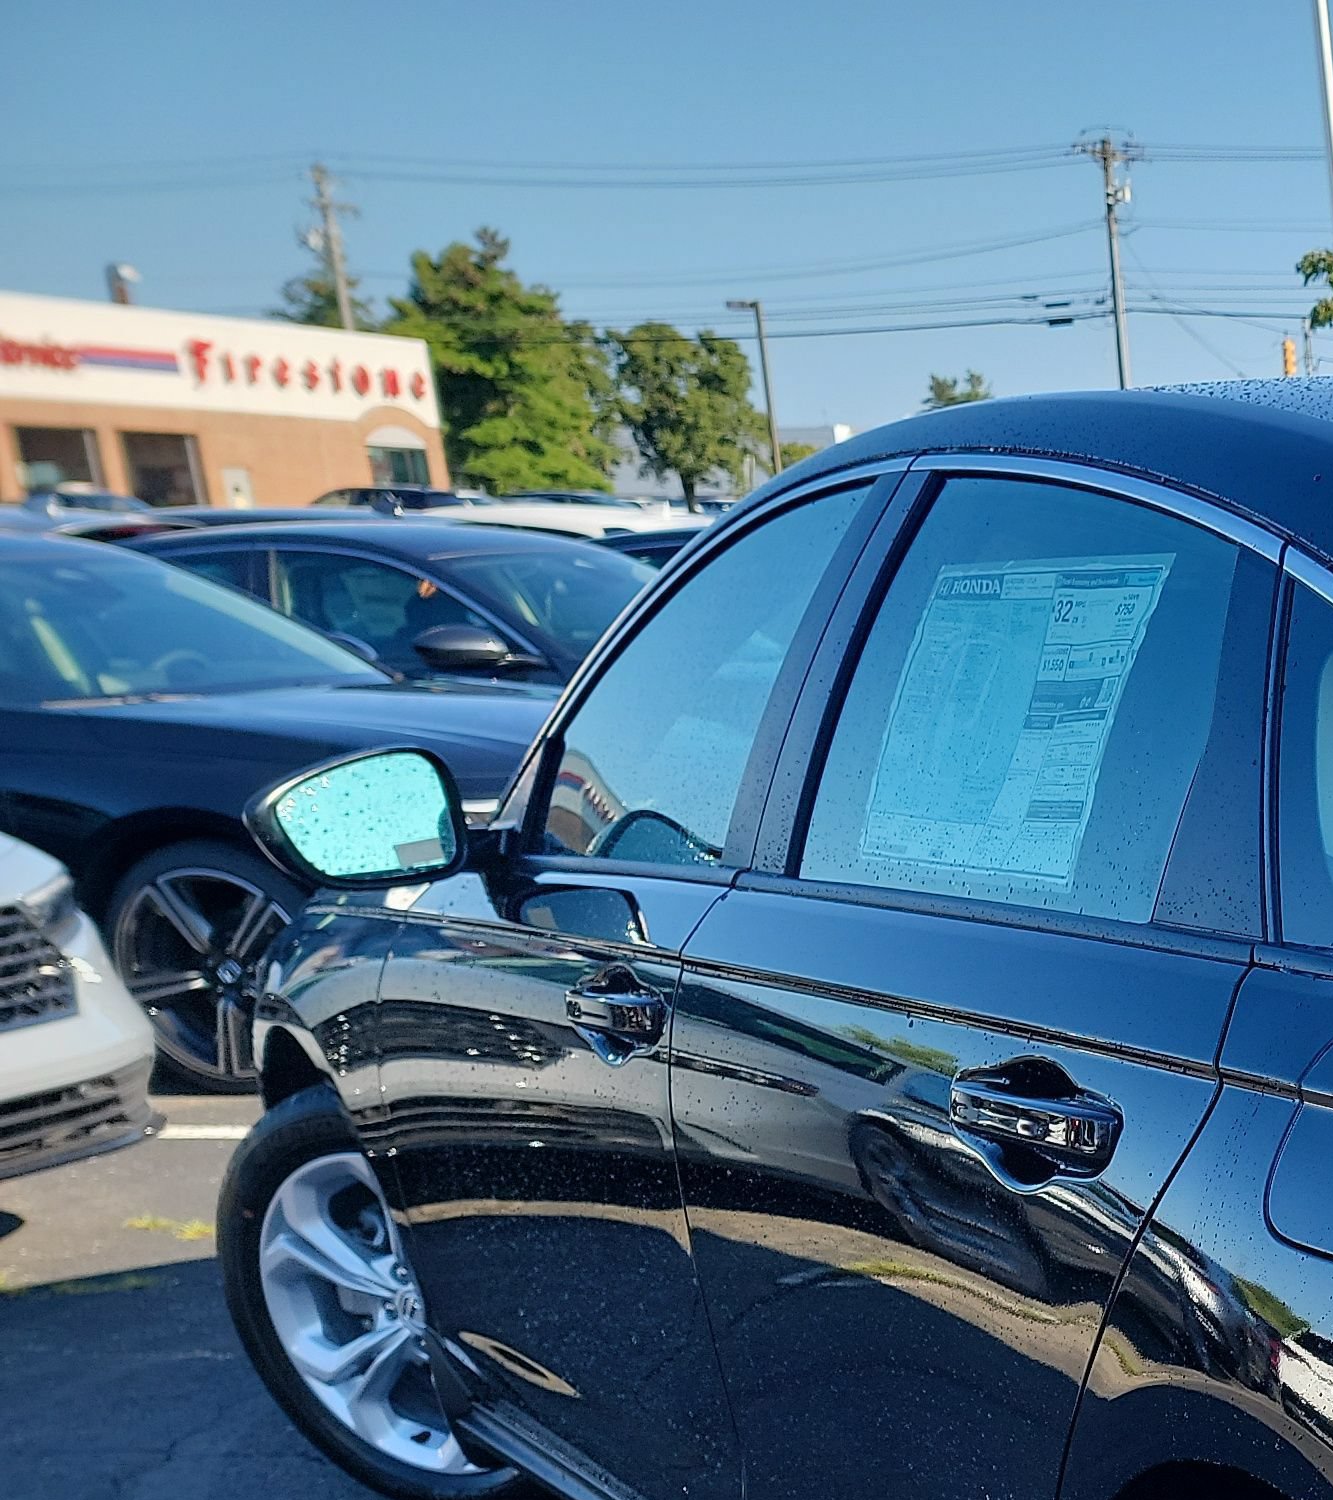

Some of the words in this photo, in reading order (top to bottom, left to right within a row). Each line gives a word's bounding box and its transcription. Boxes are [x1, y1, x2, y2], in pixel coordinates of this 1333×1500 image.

[190, 339, 426, 400] Firestone
[951, 579, 1000, 595] HONDA
[1054, 600, 1073, 623] 32
